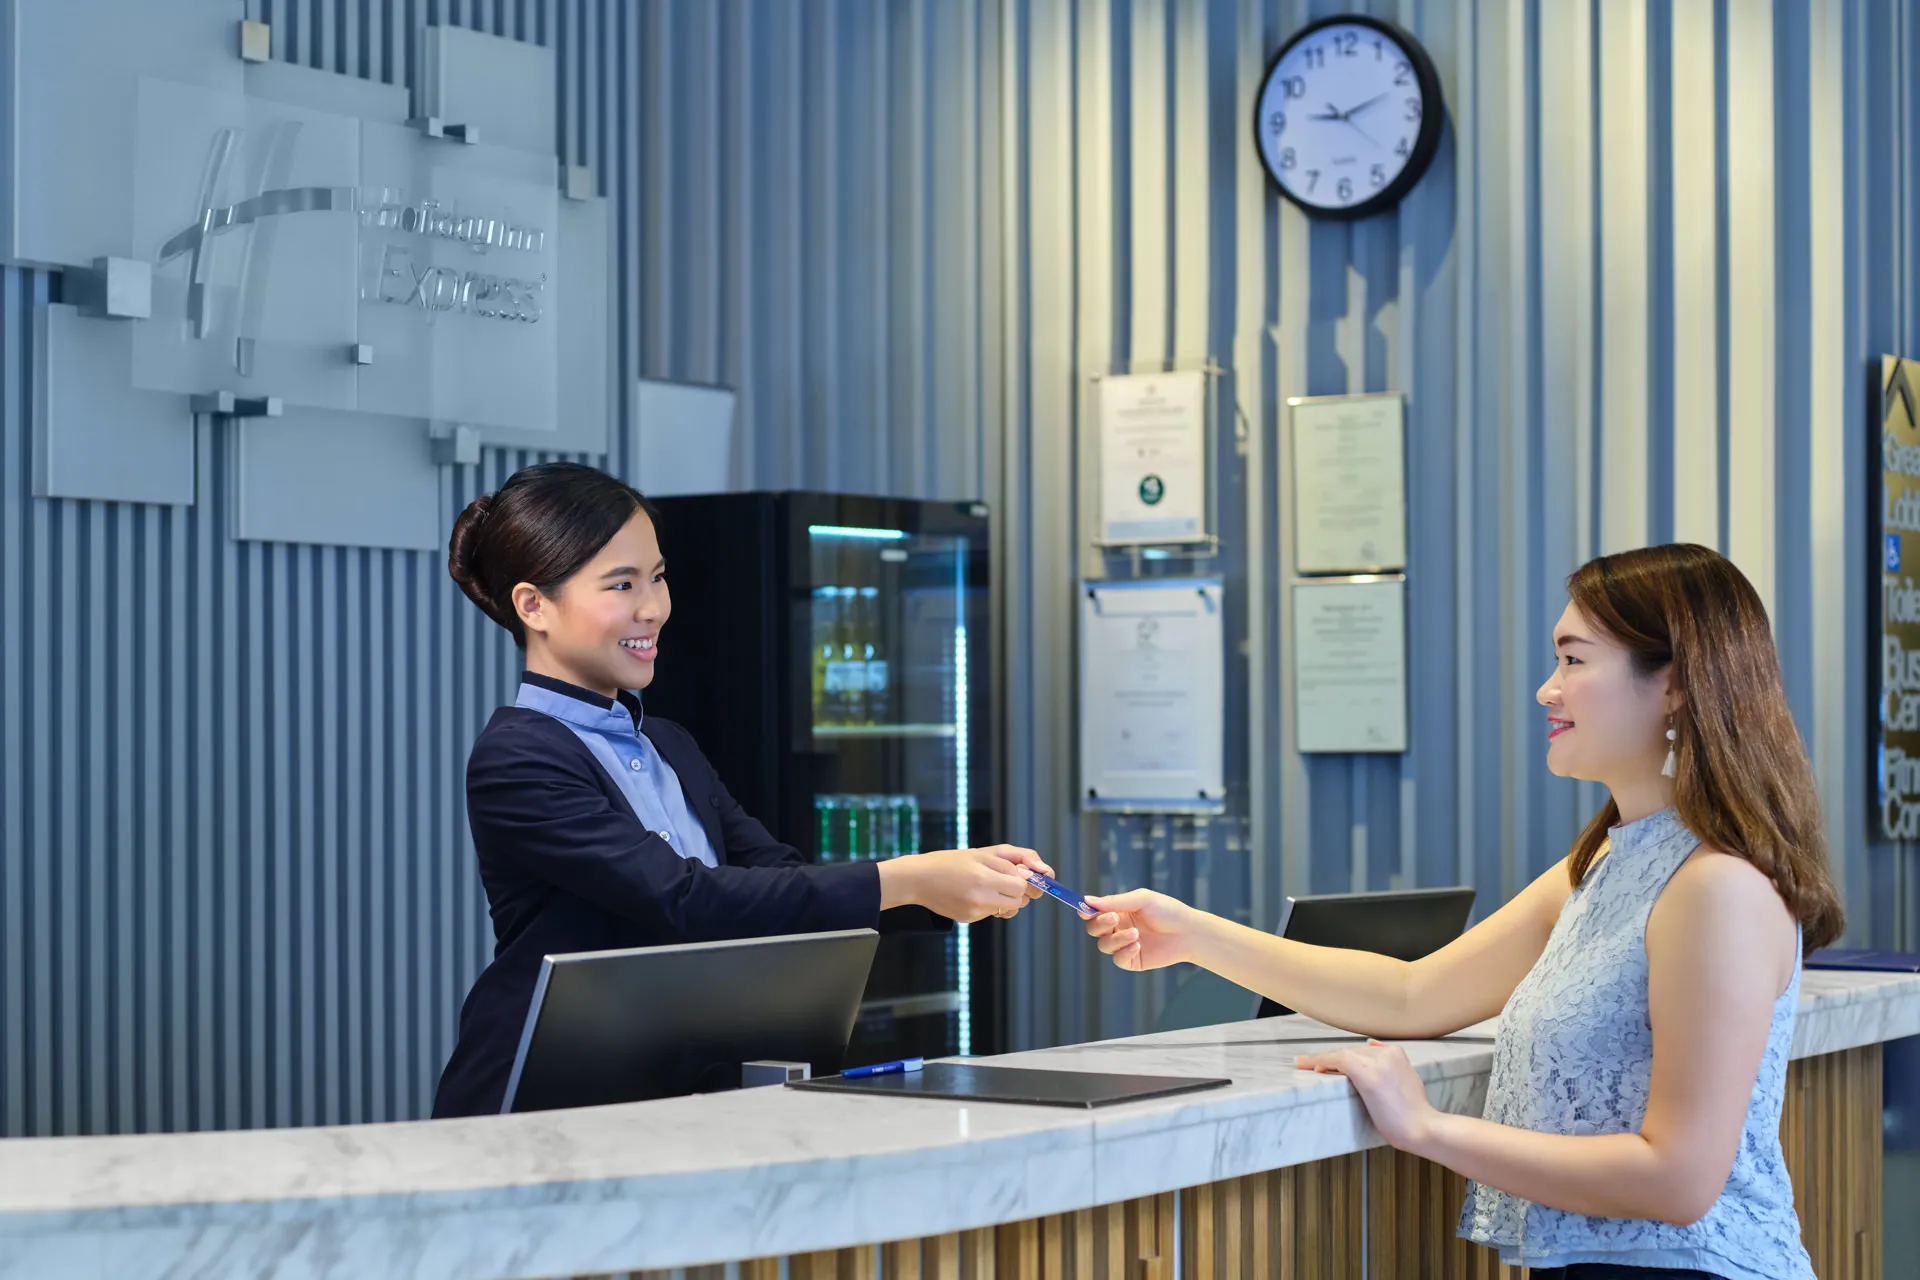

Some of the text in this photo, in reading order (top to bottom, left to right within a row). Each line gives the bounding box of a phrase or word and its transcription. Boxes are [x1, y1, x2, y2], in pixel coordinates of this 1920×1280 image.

[1333, 31, 1358, 57] 12
[1373, 39, 1383, 62] 1
[1304, 45, 1325, 69] 11
[1393, 61, 1411, 86] 2
[1281, 75, 1306, 99] 10
[1404, 98, 1421, 122] 3
[1269, 111, 1286, 135] 9
[1281, 147, 1297, 170] 8
[1394, 137, 1409, 161] 4
[1305, 169, 1321, 194] 7
[1369, 164, 1386, 188] 5
[1337, 177, 1353, 201] 6
